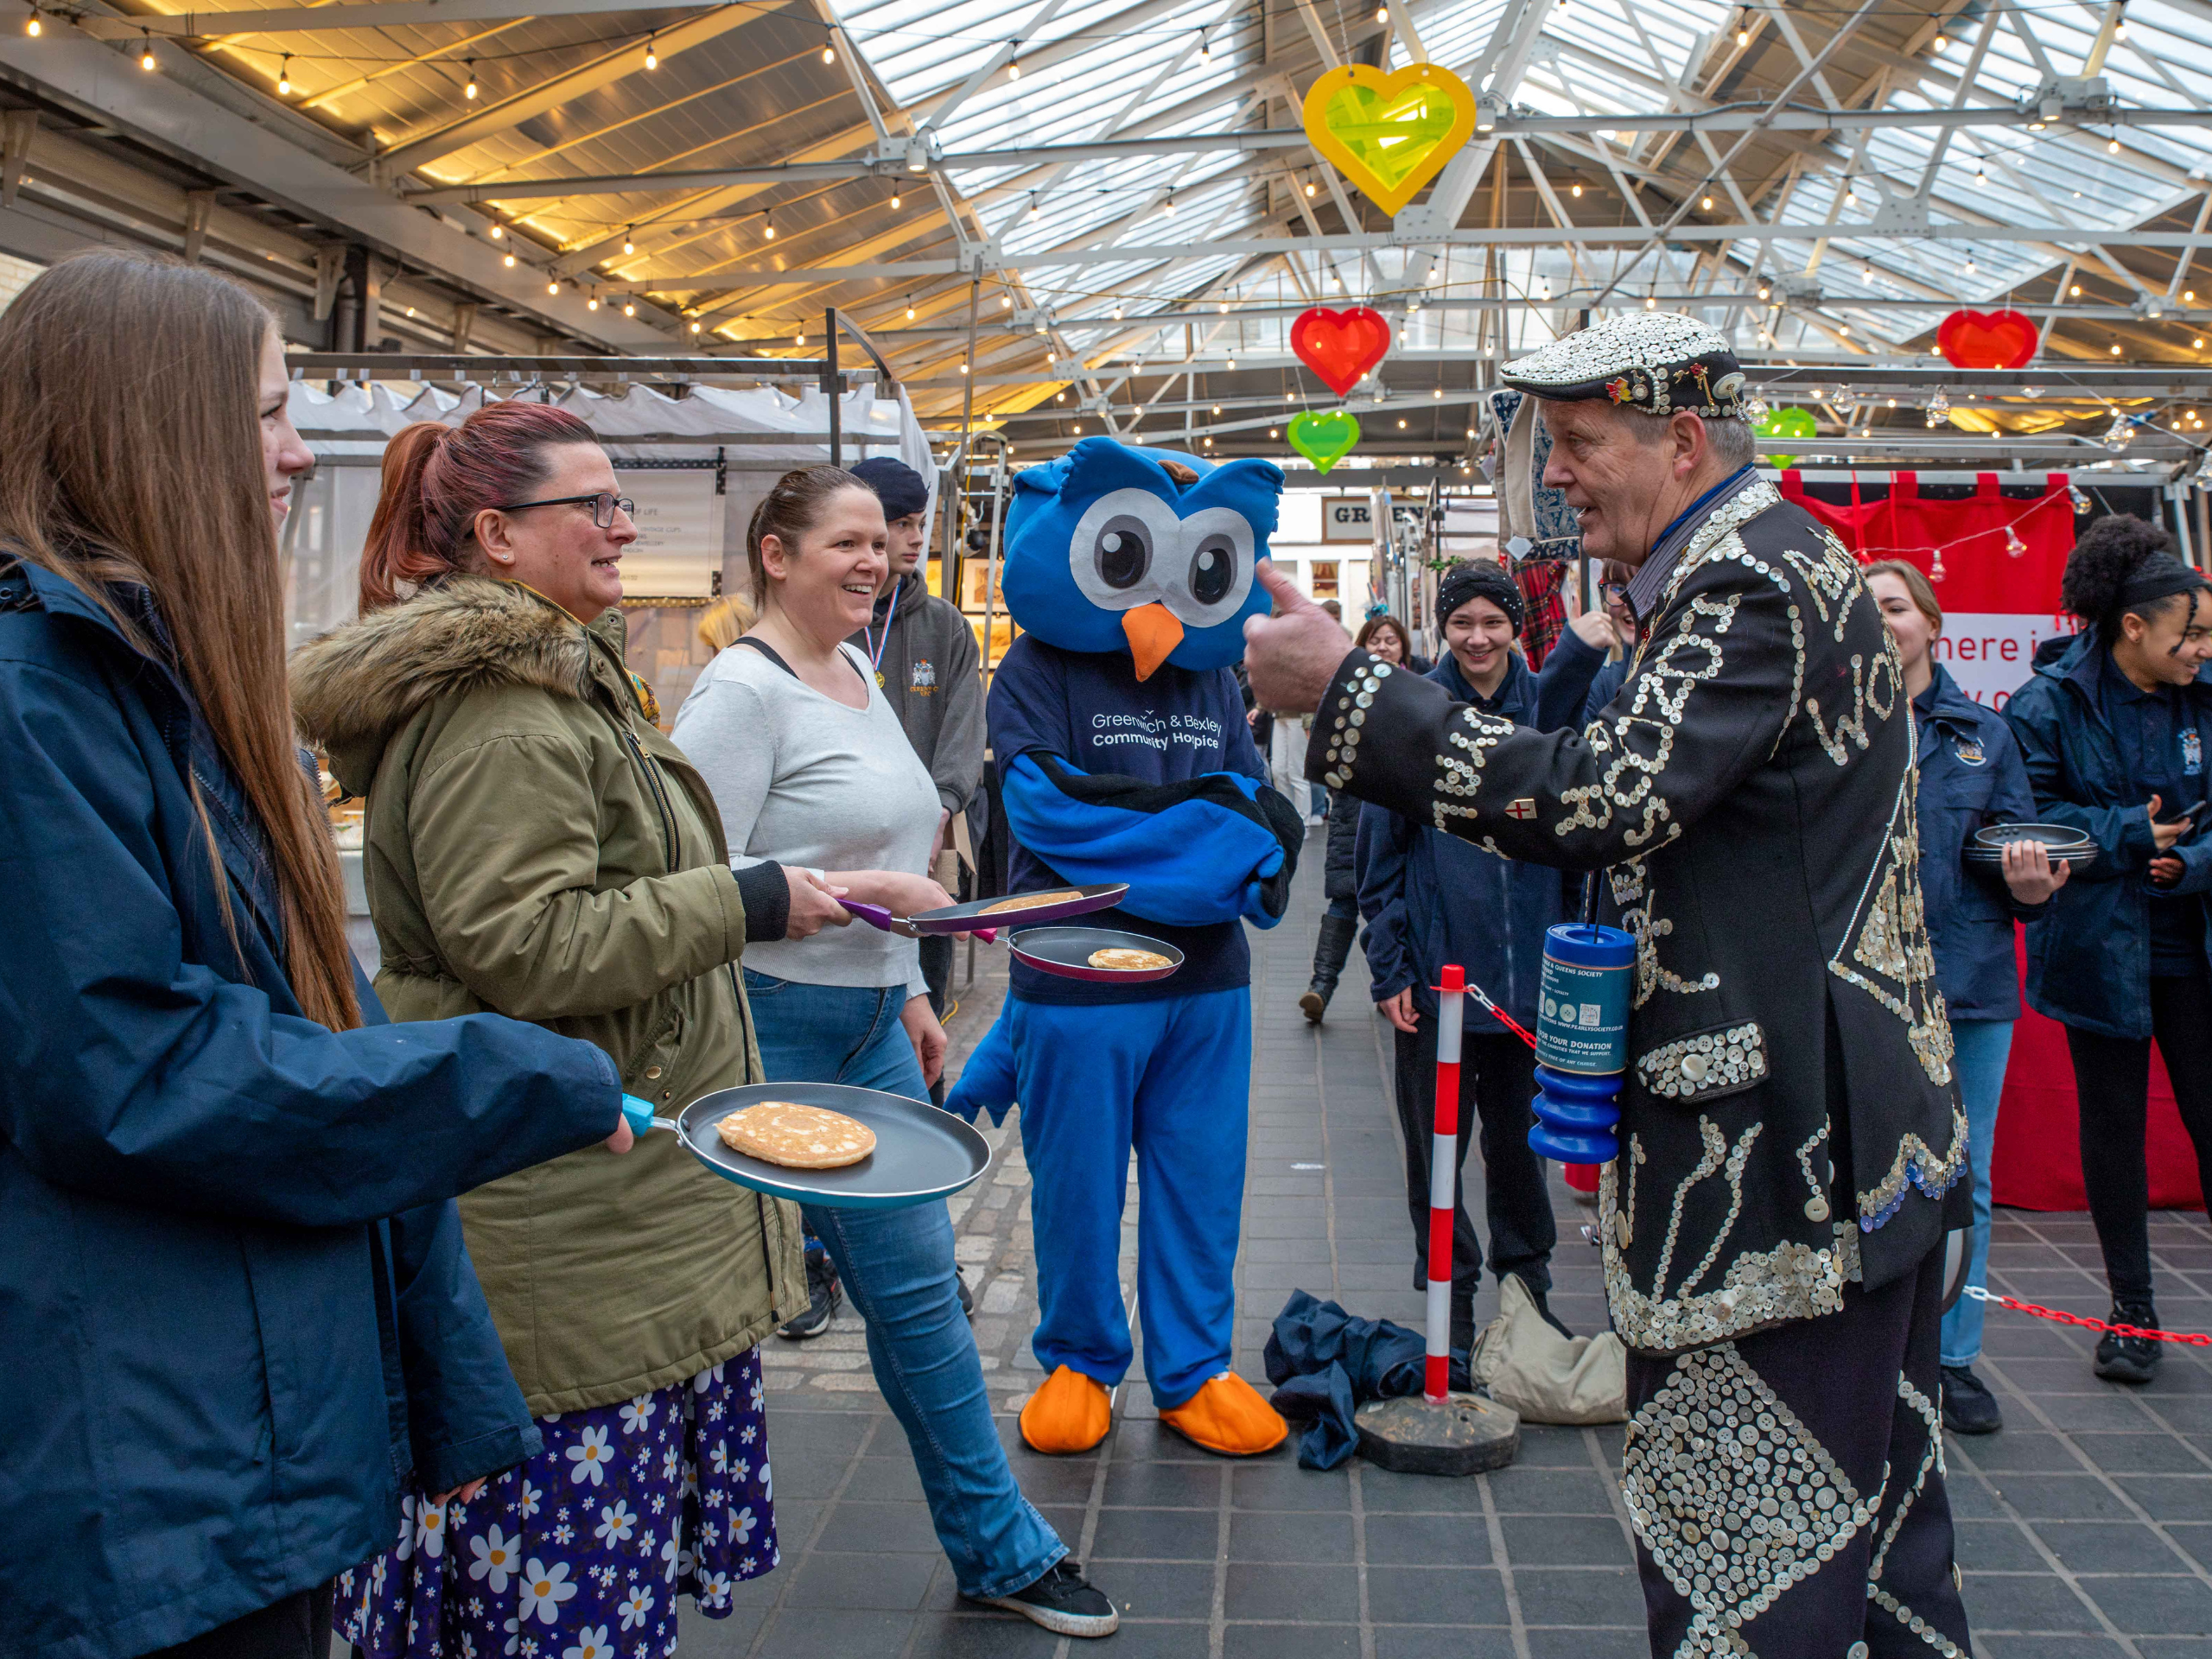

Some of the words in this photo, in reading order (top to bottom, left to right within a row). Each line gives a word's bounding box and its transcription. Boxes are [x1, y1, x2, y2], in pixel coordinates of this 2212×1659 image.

[1335, 506, 1424, 523] GREN
[1092, 714, 1166, 734] Greenwich
[1170, 715, 1181, 728] &
[1184, 715, 1221, 738] Bexley
[1093, 734, 1168, 751] Community
[1554, 964, 1576, 975] QUEENS
[1577, 969, 1604, 978] SOCIETY
[1539, 1029, 1548, 1039] FOR
[1549, 1035, 1568, 1046] YOUR
[1570, 1040, 1612, 1051] DONATION
[1548, 1043, 1567, 1052] CHARITIES
